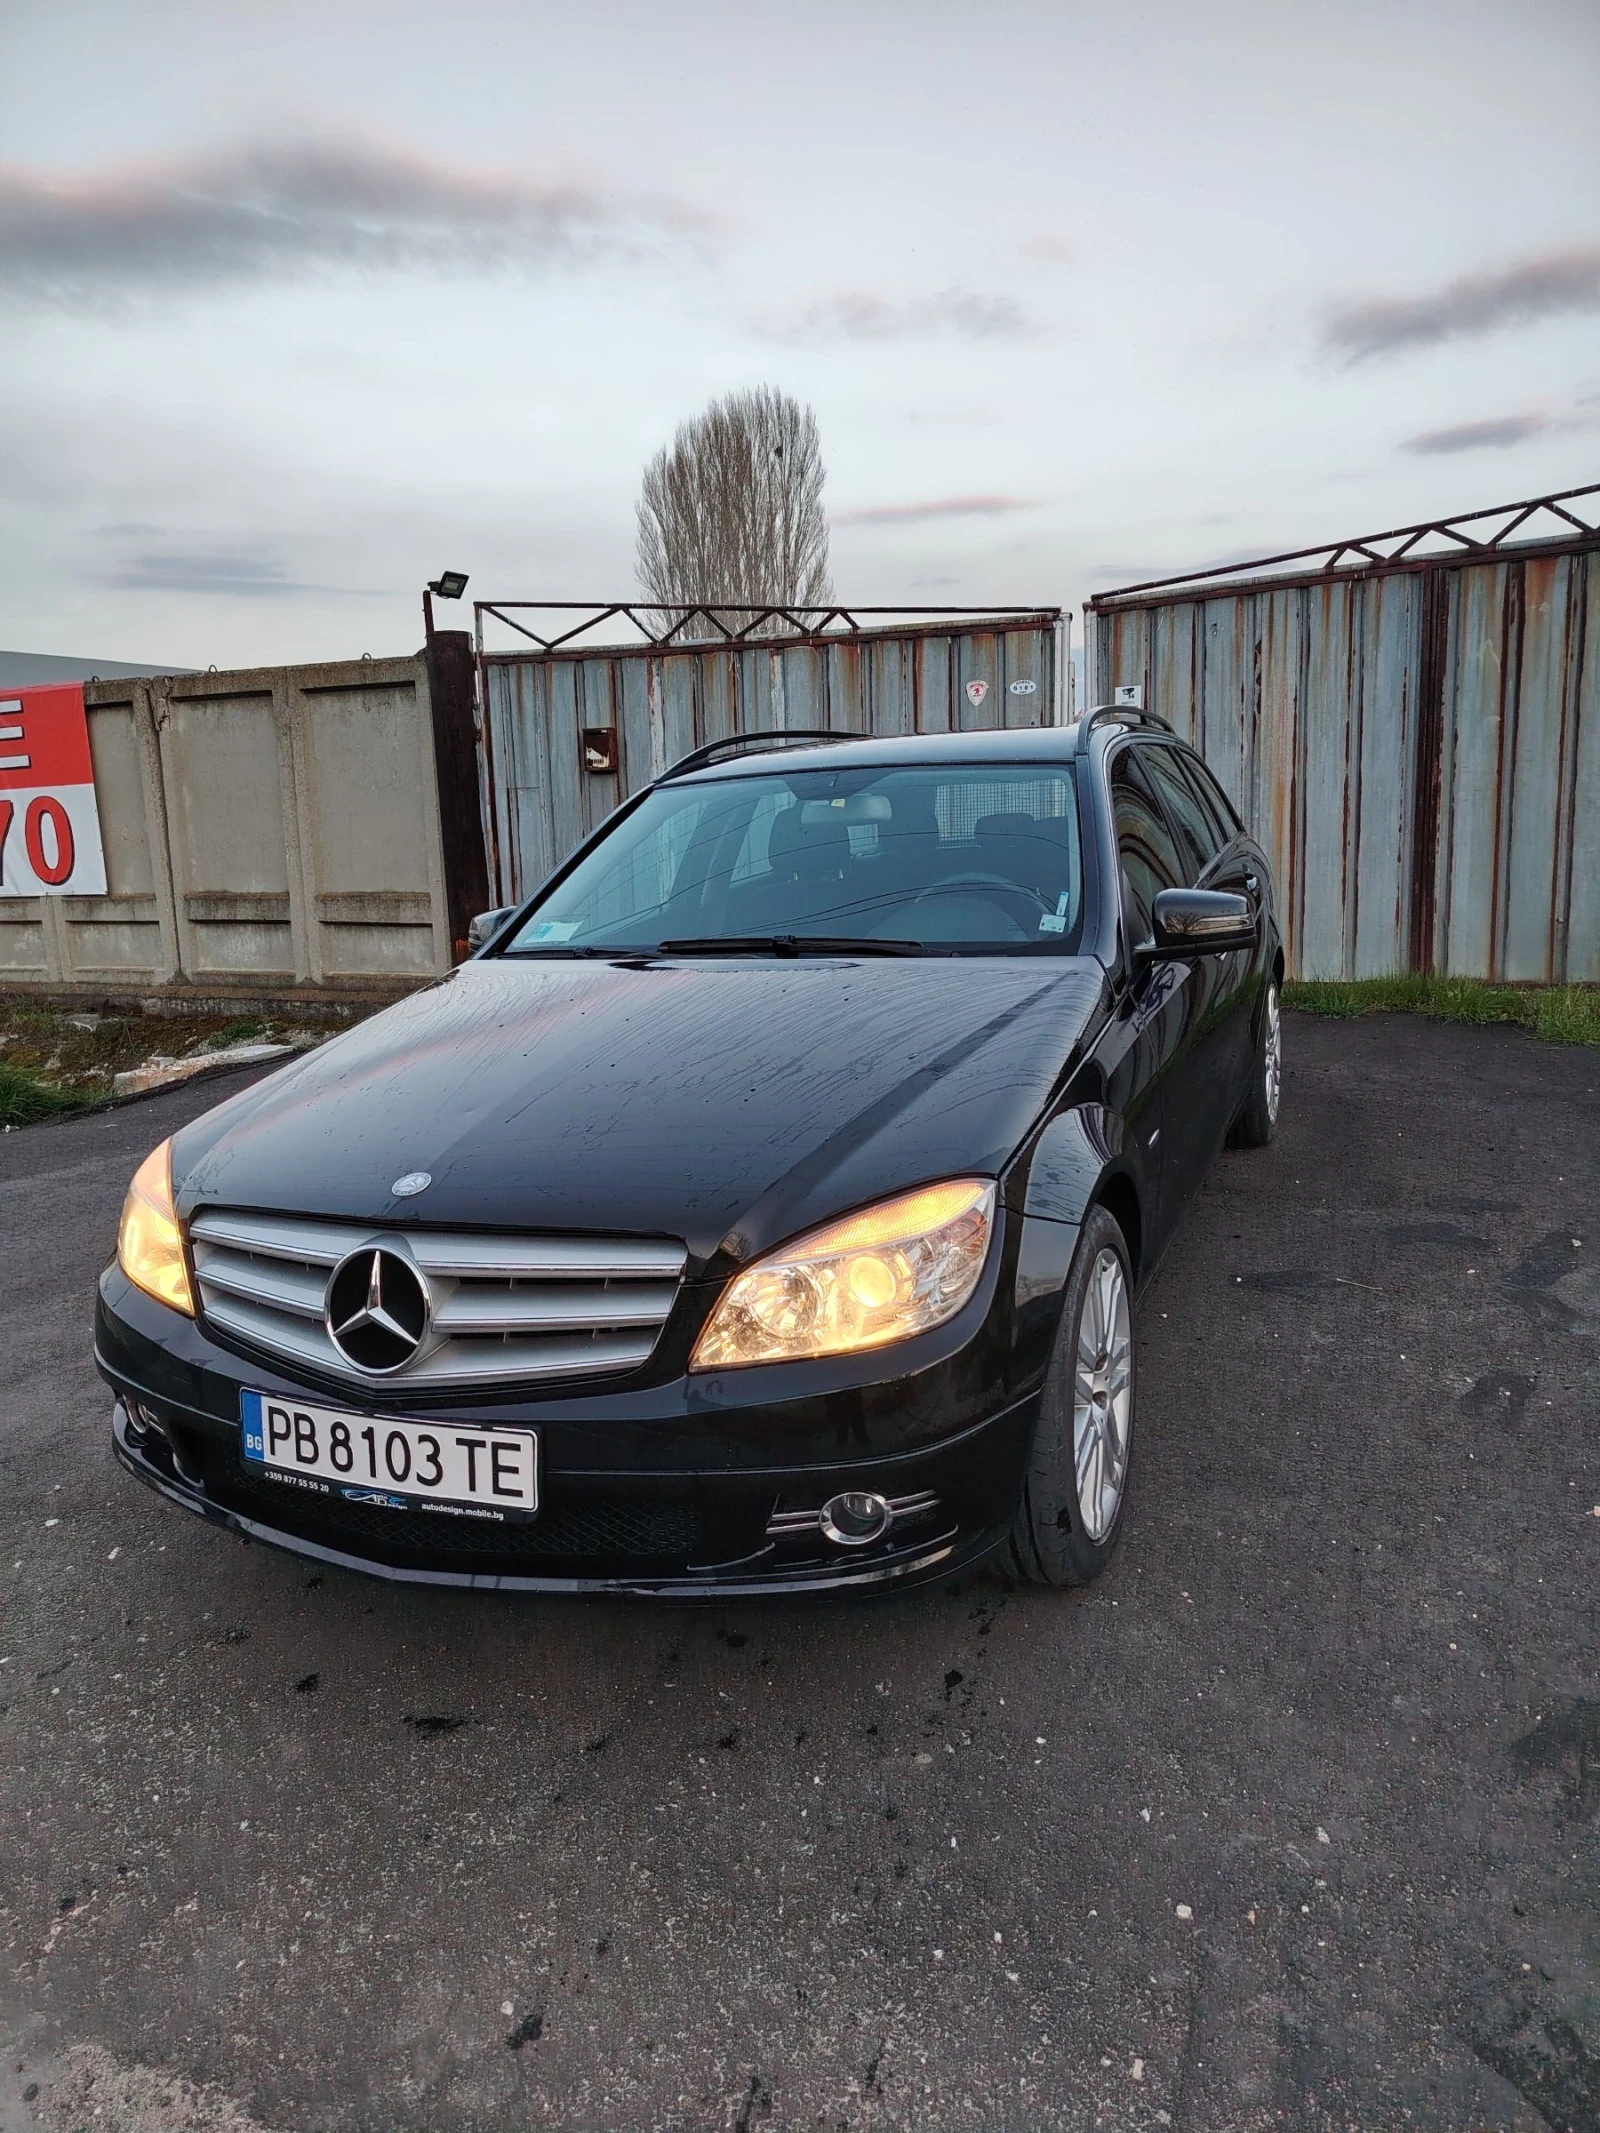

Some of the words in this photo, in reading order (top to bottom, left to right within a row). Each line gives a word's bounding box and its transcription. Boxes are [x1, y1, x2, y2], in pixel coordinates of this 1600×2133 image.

[246, 1433, 263, 1451] BG
[267, 1405, 319, 1465] PB
[330, 1421, 443, 1487] 8103
[455, 1437, 524, 1498] TE
[264, 1471, 282, 1481] +359
[283, 1475, 296, 1484] 877
[298, 1479, 308, 1487] 55
[309, 1481, 318, 1490] 55
[320, 1483, 329, 1493] 20
[421, 1503, 504, 1521] autodesign.mobile.bg
